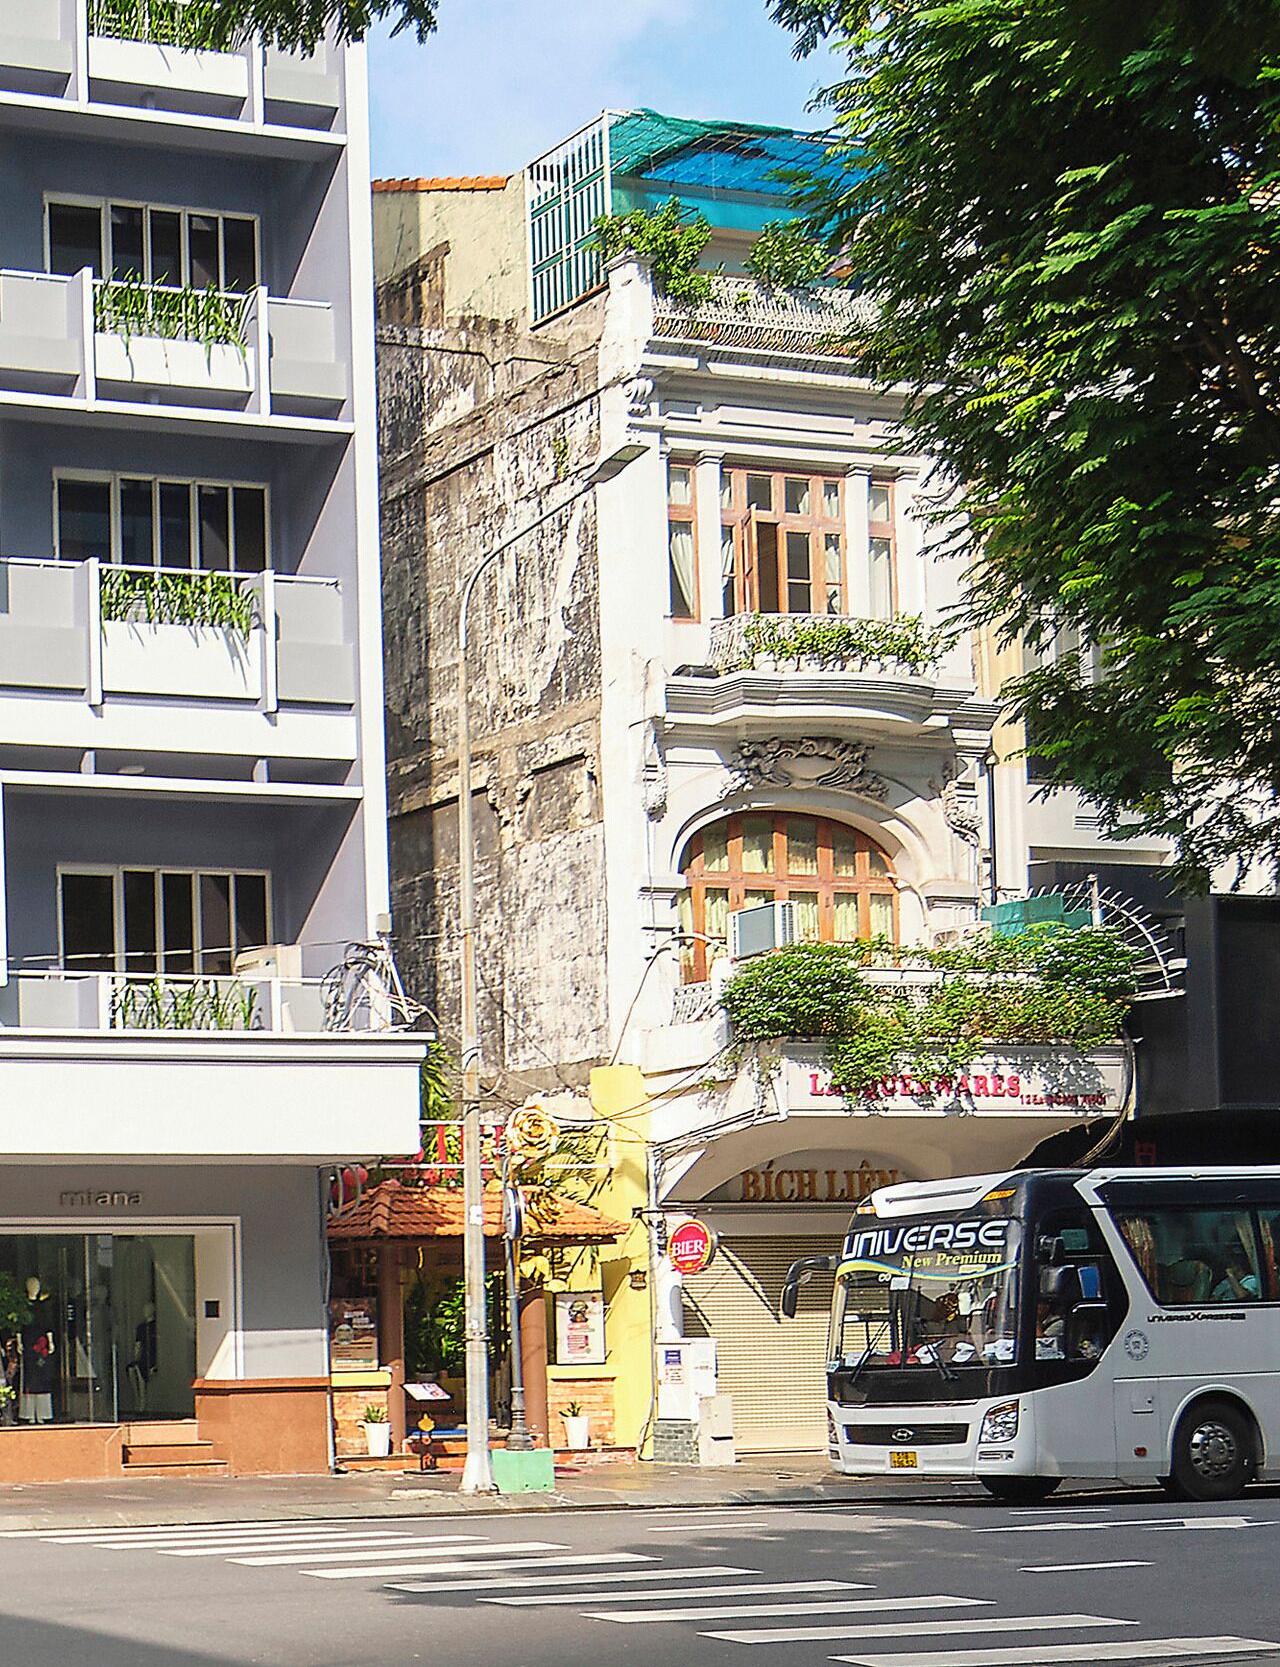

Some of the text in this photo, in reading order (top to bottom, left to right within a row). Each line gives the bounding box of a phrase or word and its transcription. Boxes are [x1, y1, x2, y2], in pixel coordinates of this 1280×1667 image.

[741, 1160, 818, 1201] BÍCH
[59, 1189, 142, 1207] miana
[671, 1239, 705, 1257] BIER
[842, 1220, 1009, 1260] UNIVERSE
[902, 1251, 1002, 1269] New Premium
